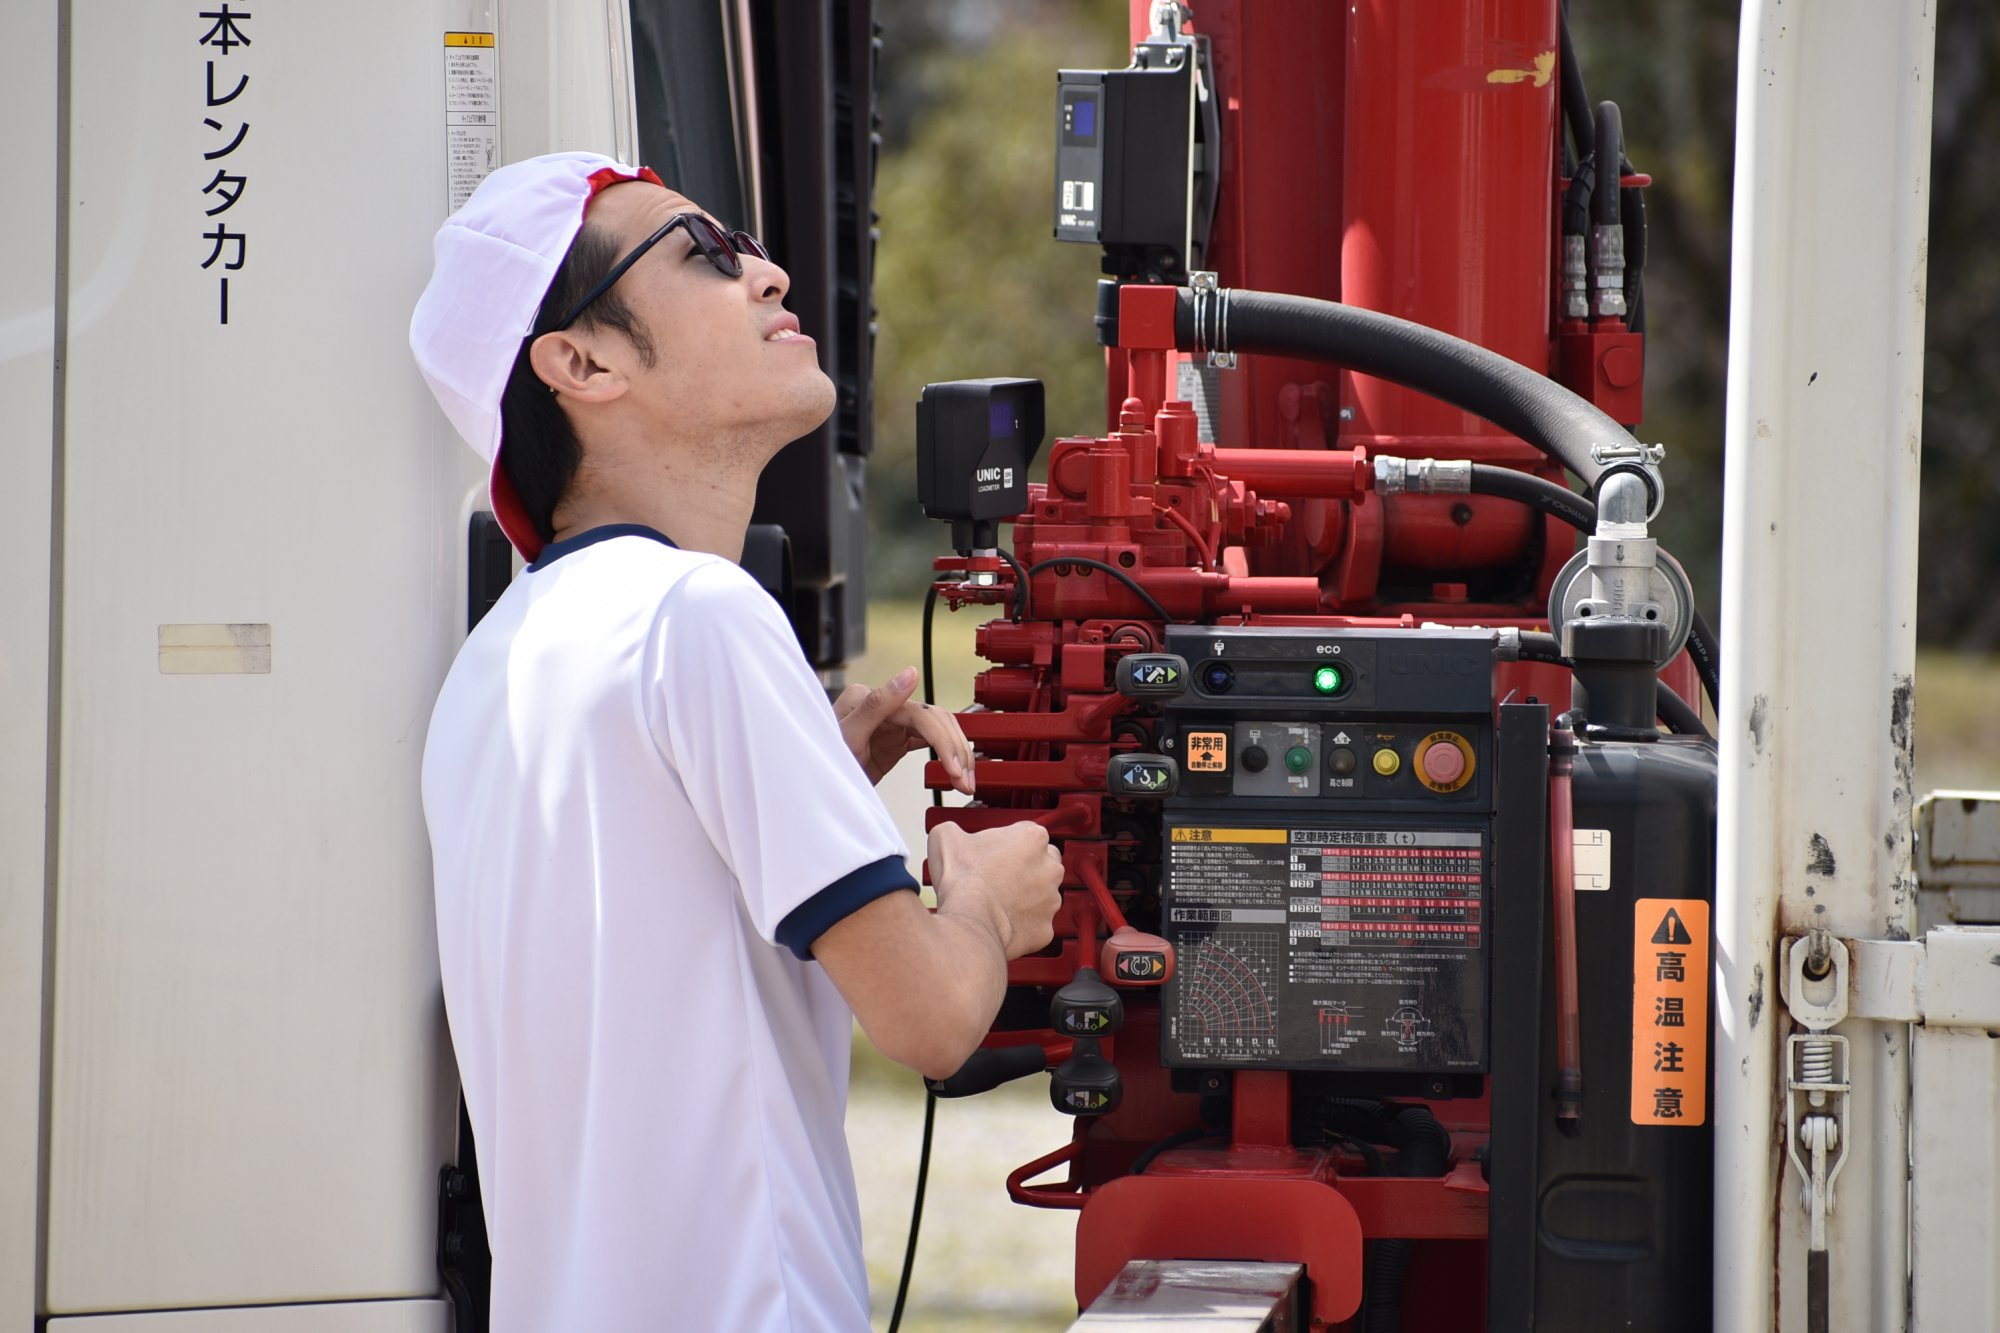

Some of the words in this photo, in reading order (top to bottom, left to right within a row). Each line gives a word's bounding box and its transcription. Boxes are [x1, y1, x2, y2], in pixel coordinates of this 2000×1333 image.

[198, 0, 252, 326] 本レンタカー
[976, 467, 1001, 482] UNIC
[1552, 500, 1590, 524] YOKOHAMA
[1316, 644, 1341, 654] eco
[1191, 736, 1223, 751] 非常用
[1330, 778, 1354, 787] 高さ制限
[1189, 830, 1212, 841] 注意
[1592, 832, 1603, 843] H
[1592, 877, 1602, 888] L
[1174, 910, 1232, 922] 作業範囲図
[1653, 951, 1686, 1118] 高温注意
